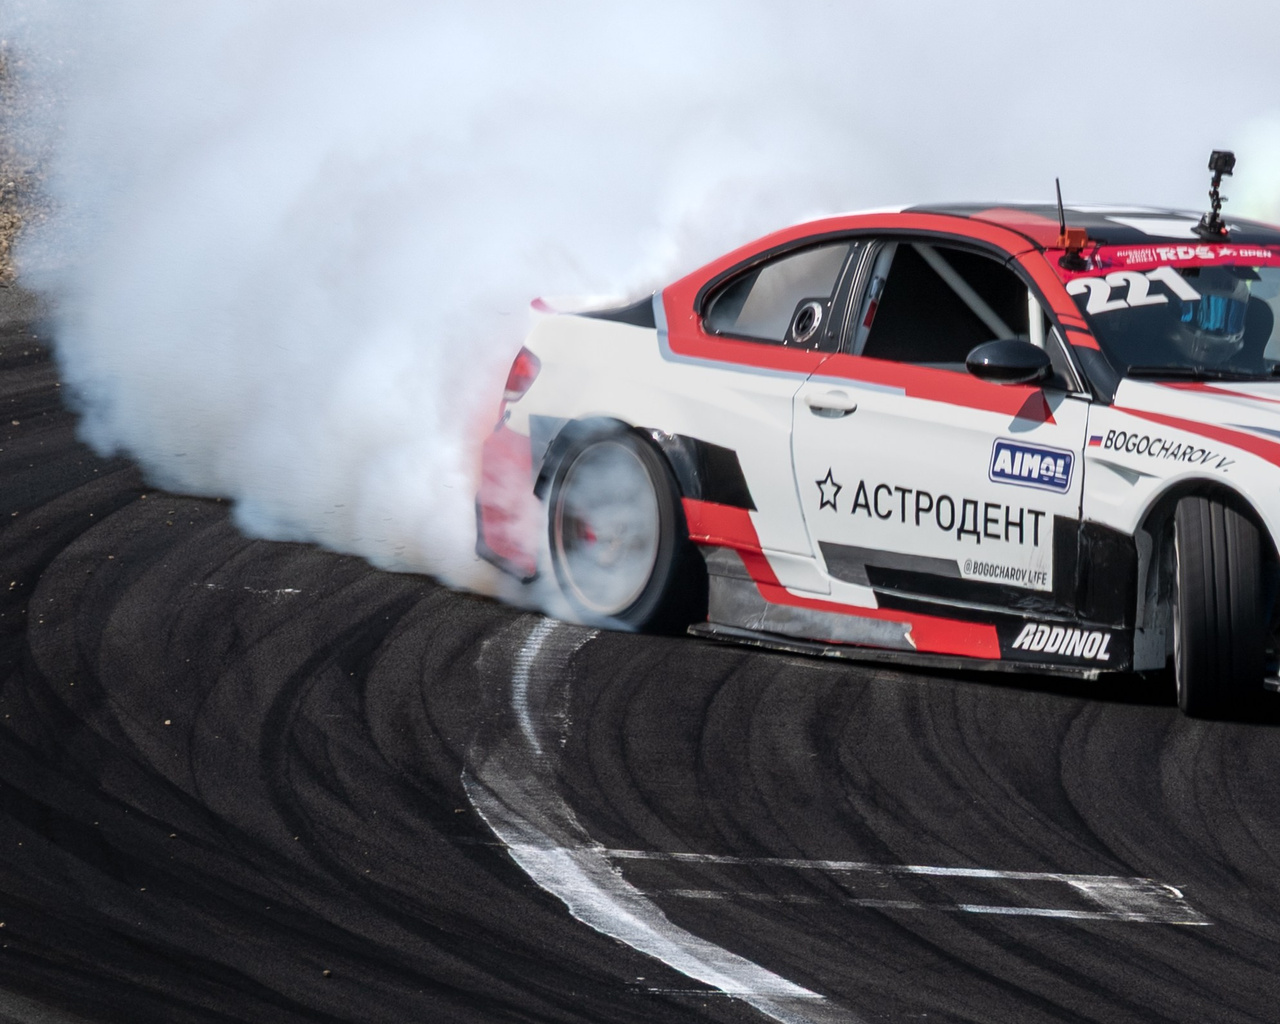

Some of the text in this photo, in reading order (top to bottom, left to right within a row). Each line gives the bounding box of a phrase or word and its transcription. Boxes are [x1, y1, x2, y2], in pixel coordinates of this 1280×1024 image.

[1156, 245, 1216, 262] RDS
[1239, 248, 1273, 259] OPEN
[1065, 265, 1202, 316] 221
[993, 448, 1068, 480] AIMOL
[1103, 429, 1220, 465] BOGOCHAROV
[850, 479, 1047, 548] АСТРОДЕНТ
[1012, 622, 1111, 661] ADDINOL
